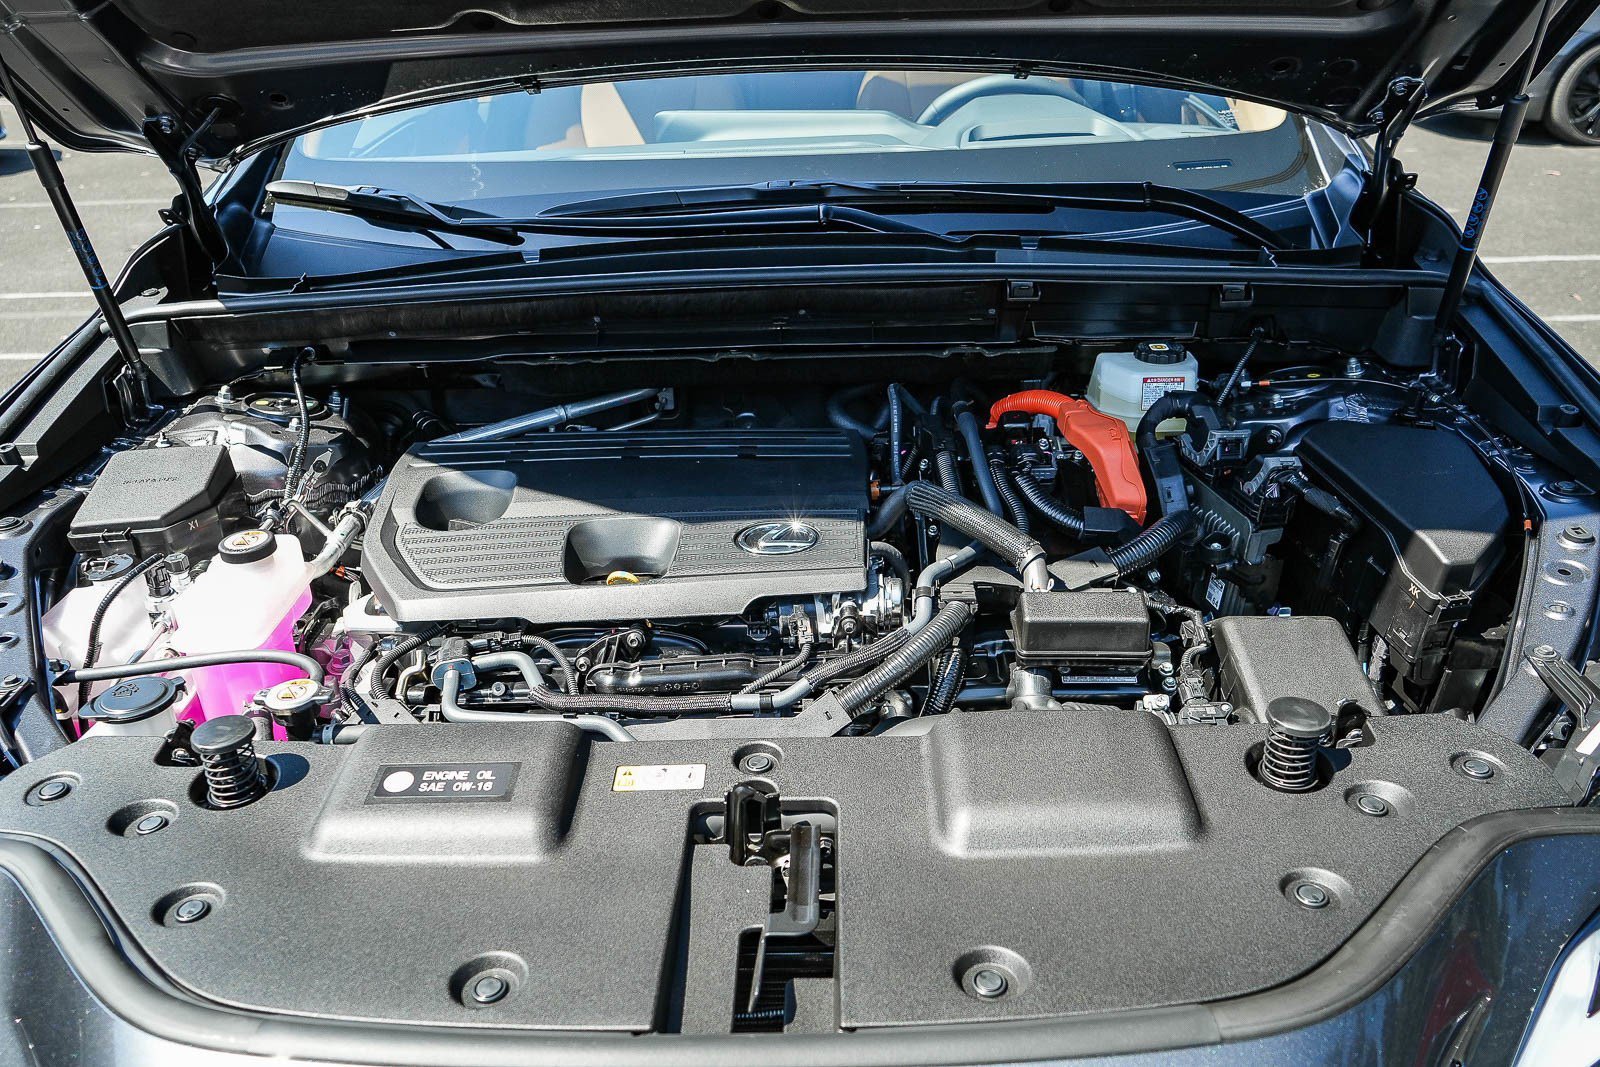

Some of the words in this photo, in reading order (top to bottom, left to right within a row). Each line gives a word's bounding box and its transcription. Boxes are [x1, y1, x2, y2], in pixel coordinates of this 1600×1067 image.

[422, 771, 470, 780] ENGINE
[476, 770, 496, 780] OIL
[418, 782, 446, 792] SAE
[452, 782, 493, 792] 0W-16
